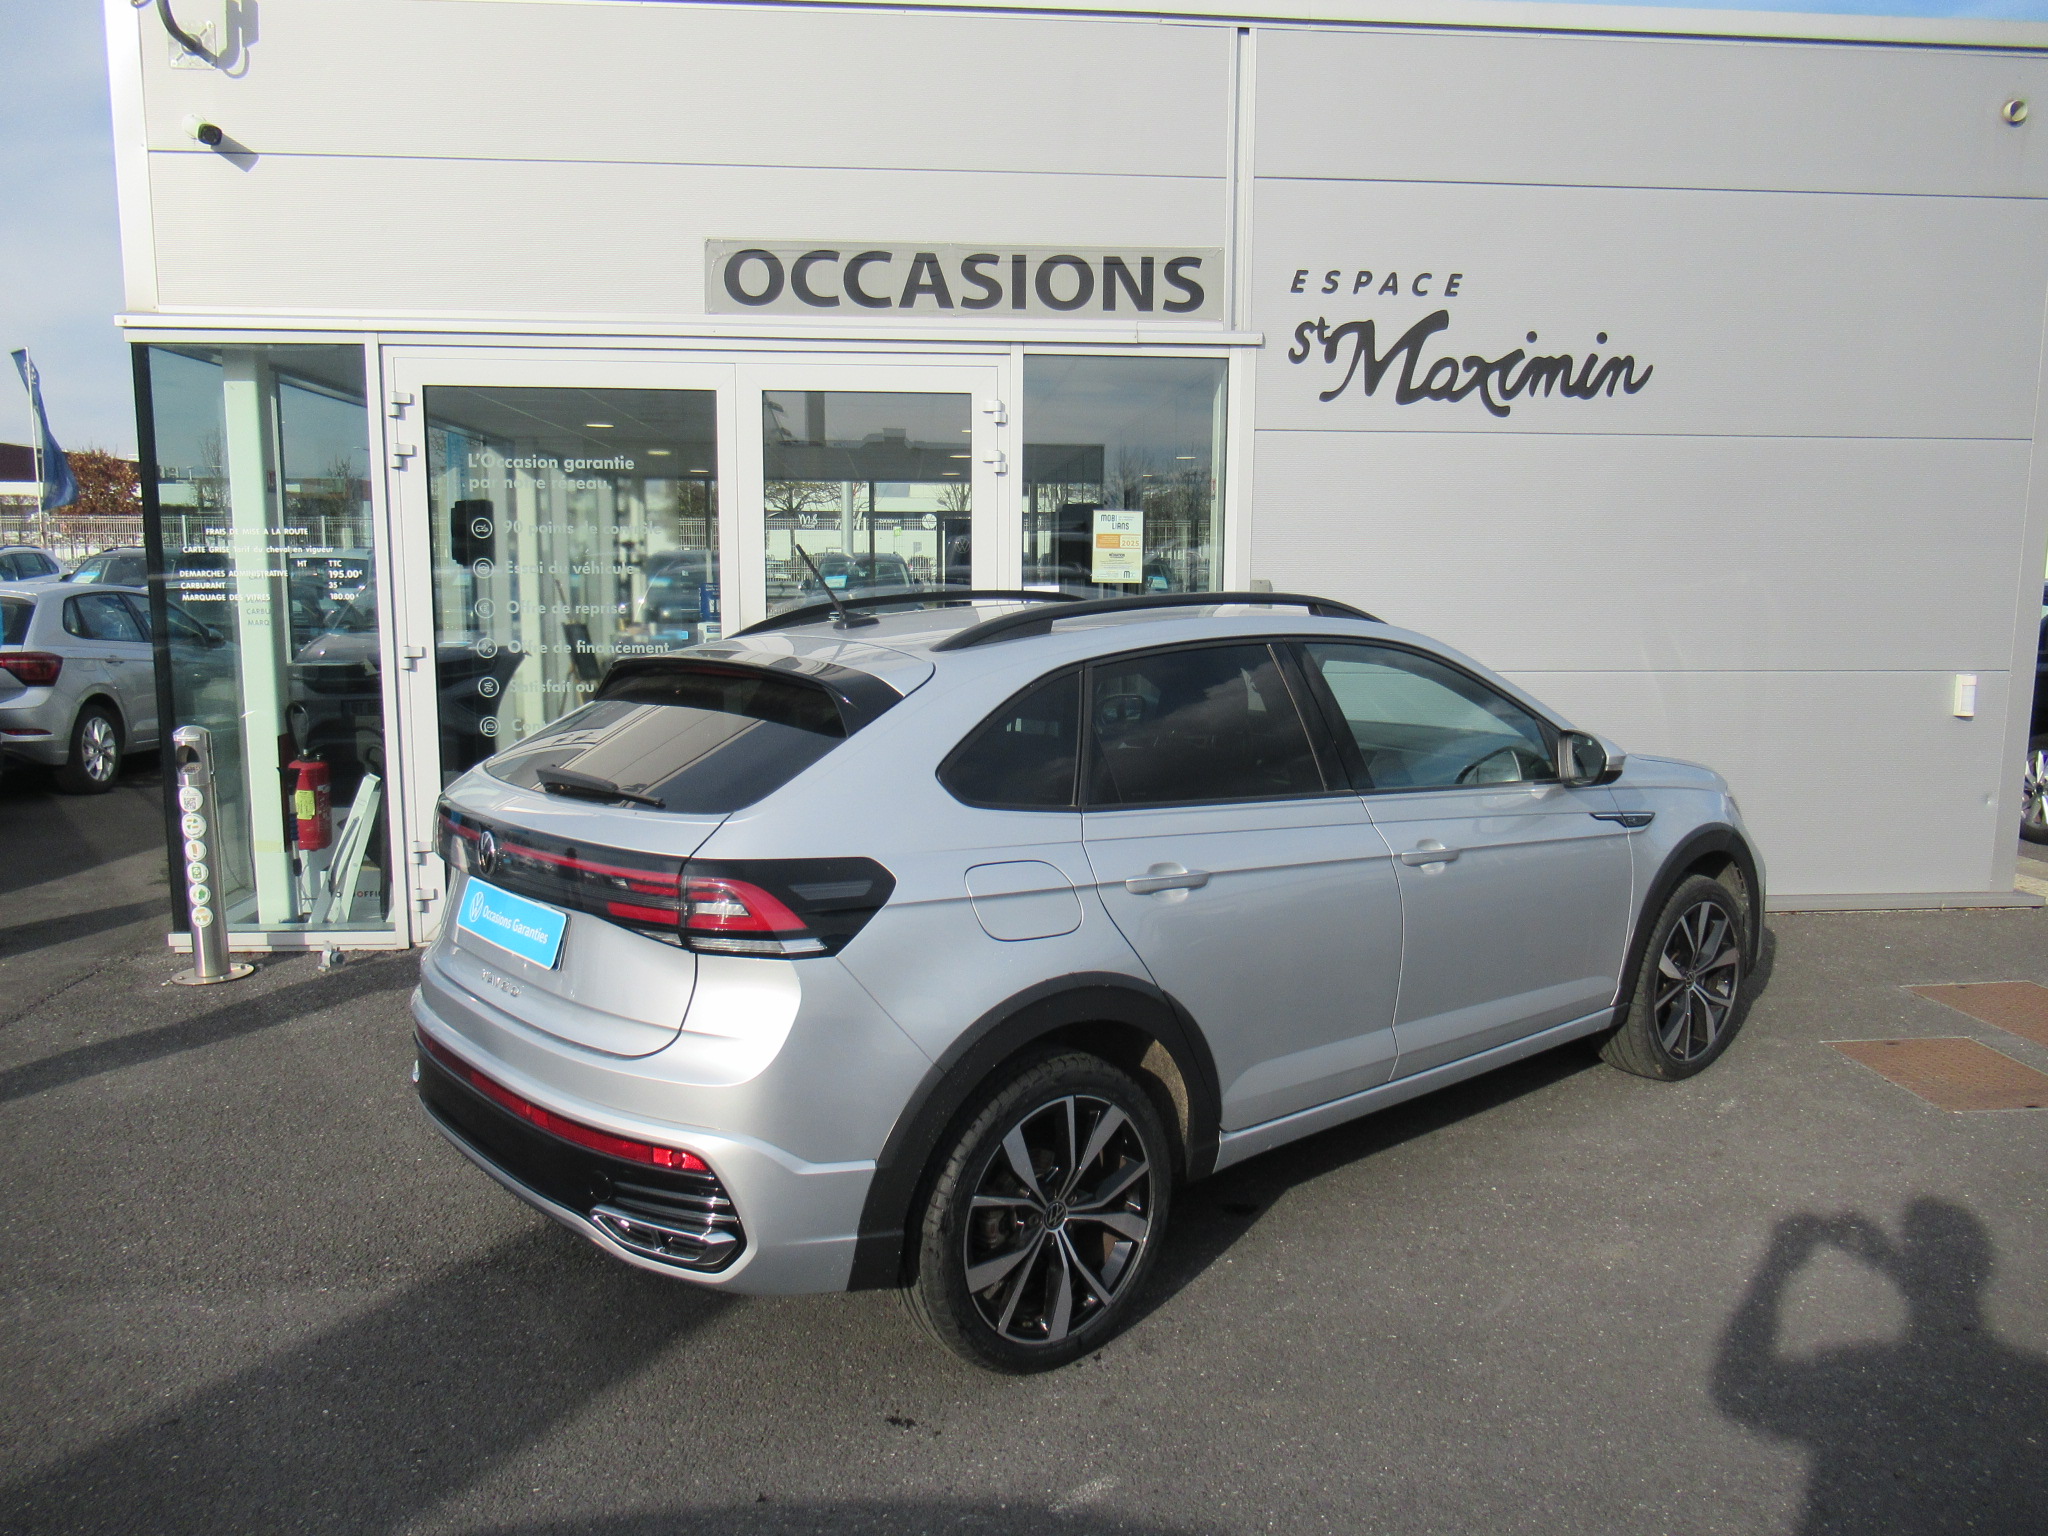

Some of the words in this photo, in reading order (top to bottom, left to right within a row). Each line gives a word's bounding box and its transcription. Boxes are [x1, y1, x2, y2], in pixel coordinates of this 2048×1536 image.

[724, 248, 1205, 313] OCCASIONS
[1290, 269, 1463, 298] ESPACE
[1288, 316, 1330, 364] St
[1319, 309, 1654, 418] Maximin
[468, 453, 559, 469] L'Occasion
[564, 455, 635, 473] garantie
[1100, 514, 1118, 522] MOBI
[1111, 522, 1130, 530] LIANS
[182, 545, 206, 553] CARTE
[266, 545, 290, 553] cheval
[306, 545, 334, 554] vigueur
[179, 570, 226, 578] DEMARCHES
[228, 570, 289, 578] ADMINISTRATIVE
[573, 560, 634, 575] véhicule
[180, 581, 226, 590] CARBURANT
[182, 593, 226, 601] MARQUAGE
[551, 600, 571, 614] de
[575, 602, 627, 617] reprise
[552, 639, 572, 653] de
[576, 639, 670, 654] financement
[575, 682, 595, 693] ou
[482, 905, 512, 930] Occasions
[511, 917, 549, 945] Garanties
